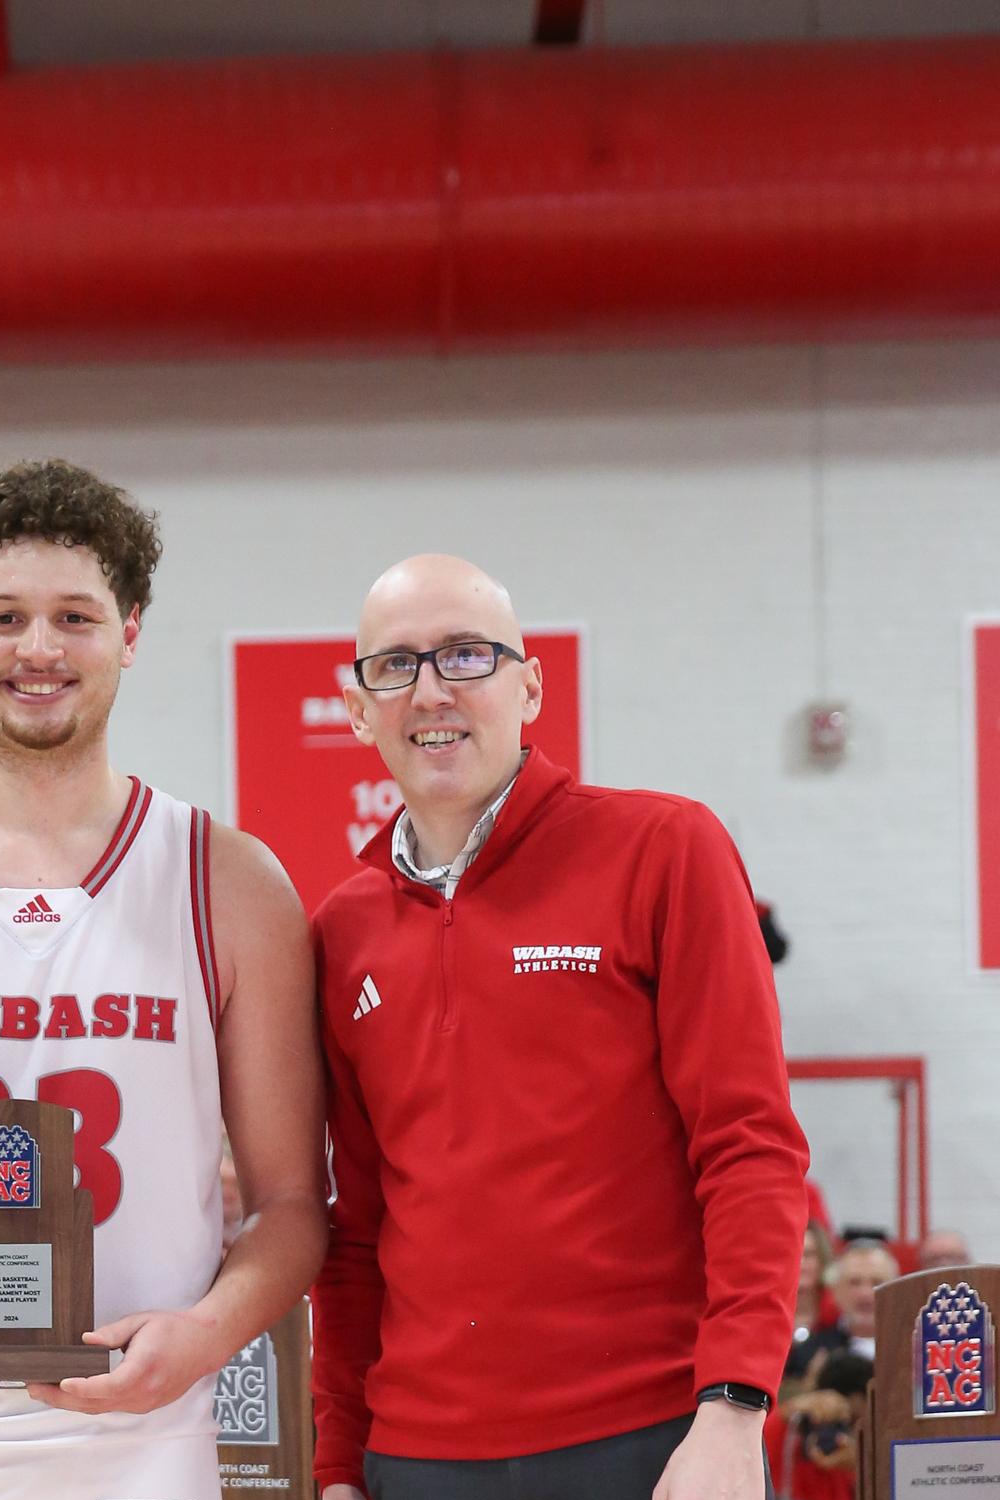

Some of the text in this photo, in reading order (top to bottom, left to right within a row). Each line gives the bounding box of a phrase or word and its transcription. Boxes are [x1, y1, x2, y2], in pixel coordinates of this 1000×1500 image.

[12, 910, 61, 924] adidas
[512, 945, 601, 960] WABASH
[513, 960, 598, 974] ATHLETICS
[926, 1338, 982, 1373] NC
[213, 1365, 265, 1400] NC
[926, 1372, 982, 1406] AC
[215, 1398, 266, 1433] AC
[218, 1464, 269, 1474] RTH COAST
[927, 1463, 984, 1473] NORTH COAST
[230, 1477, 290, 1488] CONFERENCE
[911, 1477, 948, 1485] ATHLETIC
